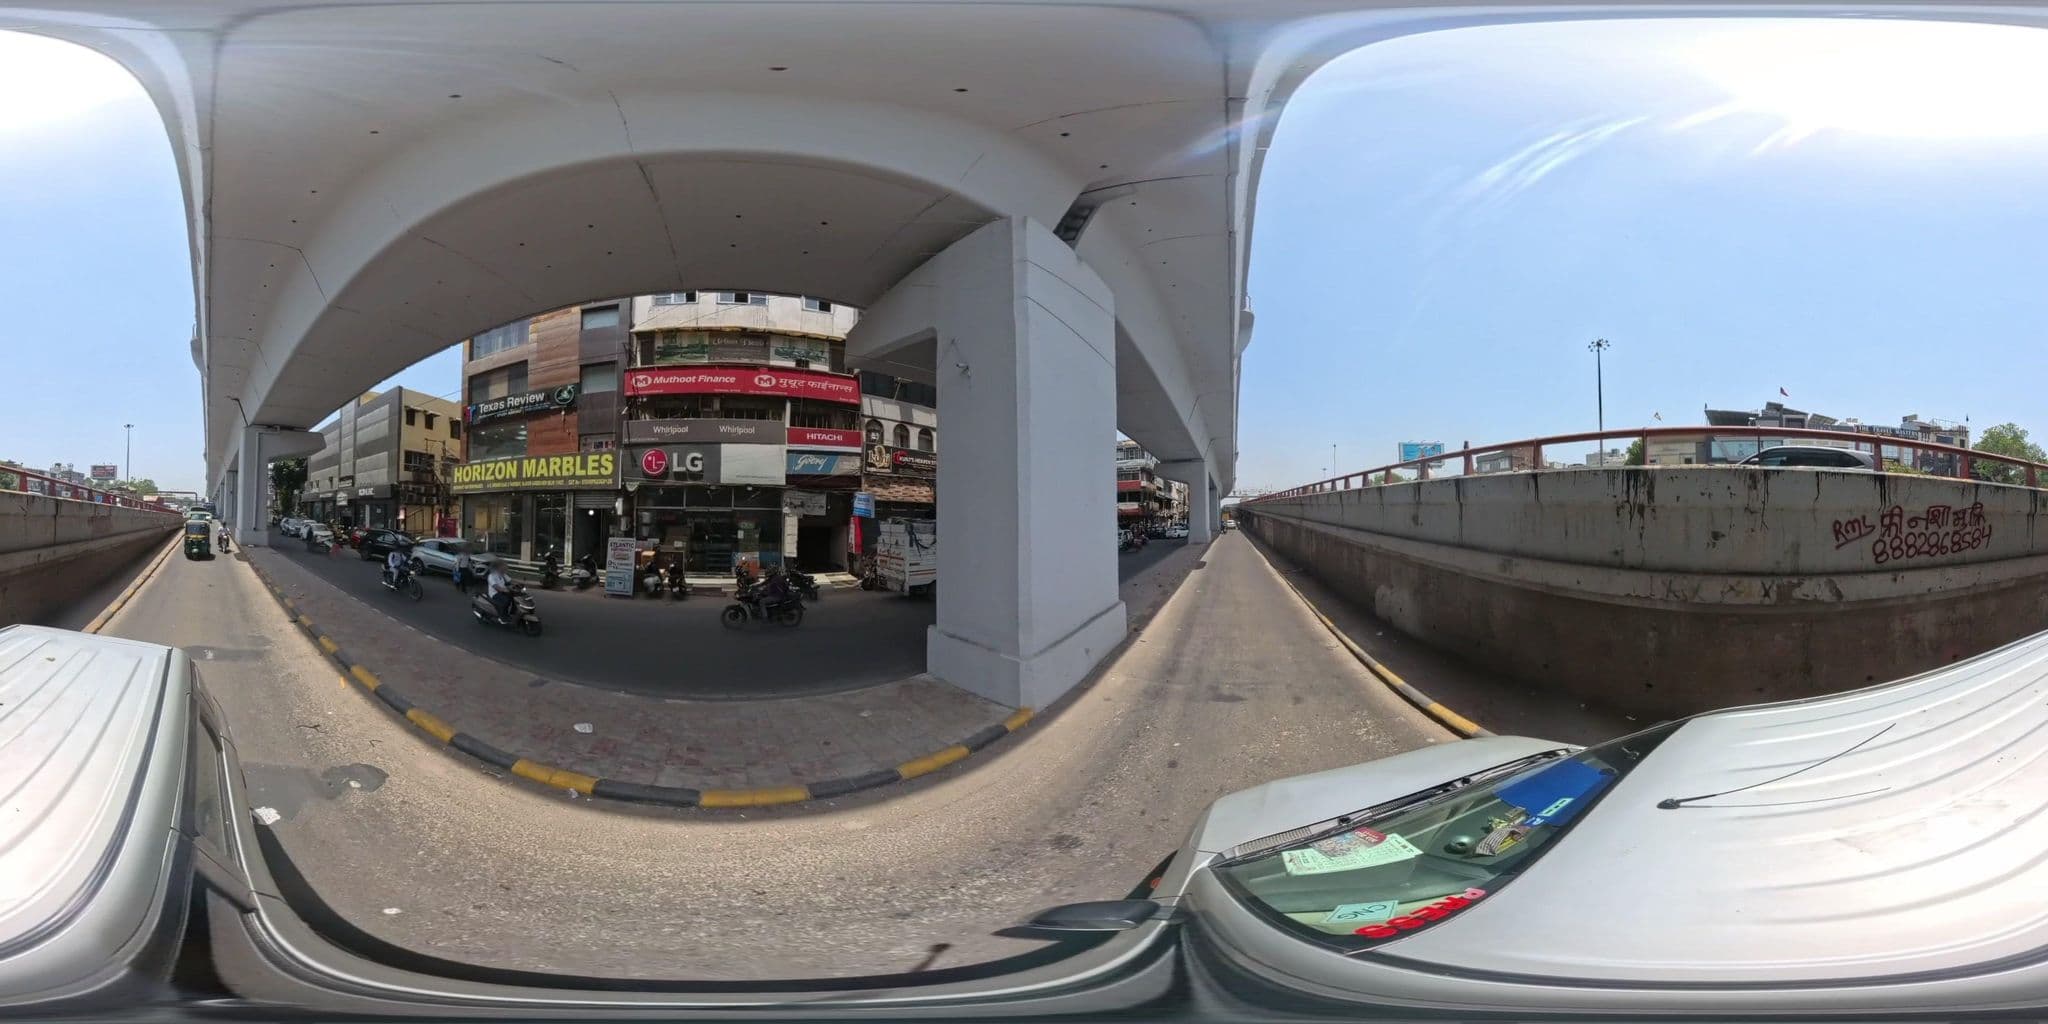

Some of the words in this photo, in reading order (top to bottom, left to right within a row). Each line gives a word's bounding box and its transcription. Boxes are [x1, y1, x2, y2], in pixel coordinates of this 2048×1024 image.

[653, 375, 696, 384] Muthoot
[698, 375, 736, 383] Finance
[479, 400, 505, 414] Texas
[507, 392, 545, 408] Review
[653, 425, 689, 435] Whirlpool
[719, 425, 755, 436] Whirlpool
[806, 433, 843, 441] HITACHI
[453, 460, 518, 483] HORIZON
[522, 454, 614, 478] MARBLES
[672, 452, 703, 472] LG
[1872, 524, 1992, 564] 8882868584
[1337, 904, 1387, 920] CNG
[1353, 887, 1487, 939] PRESS
